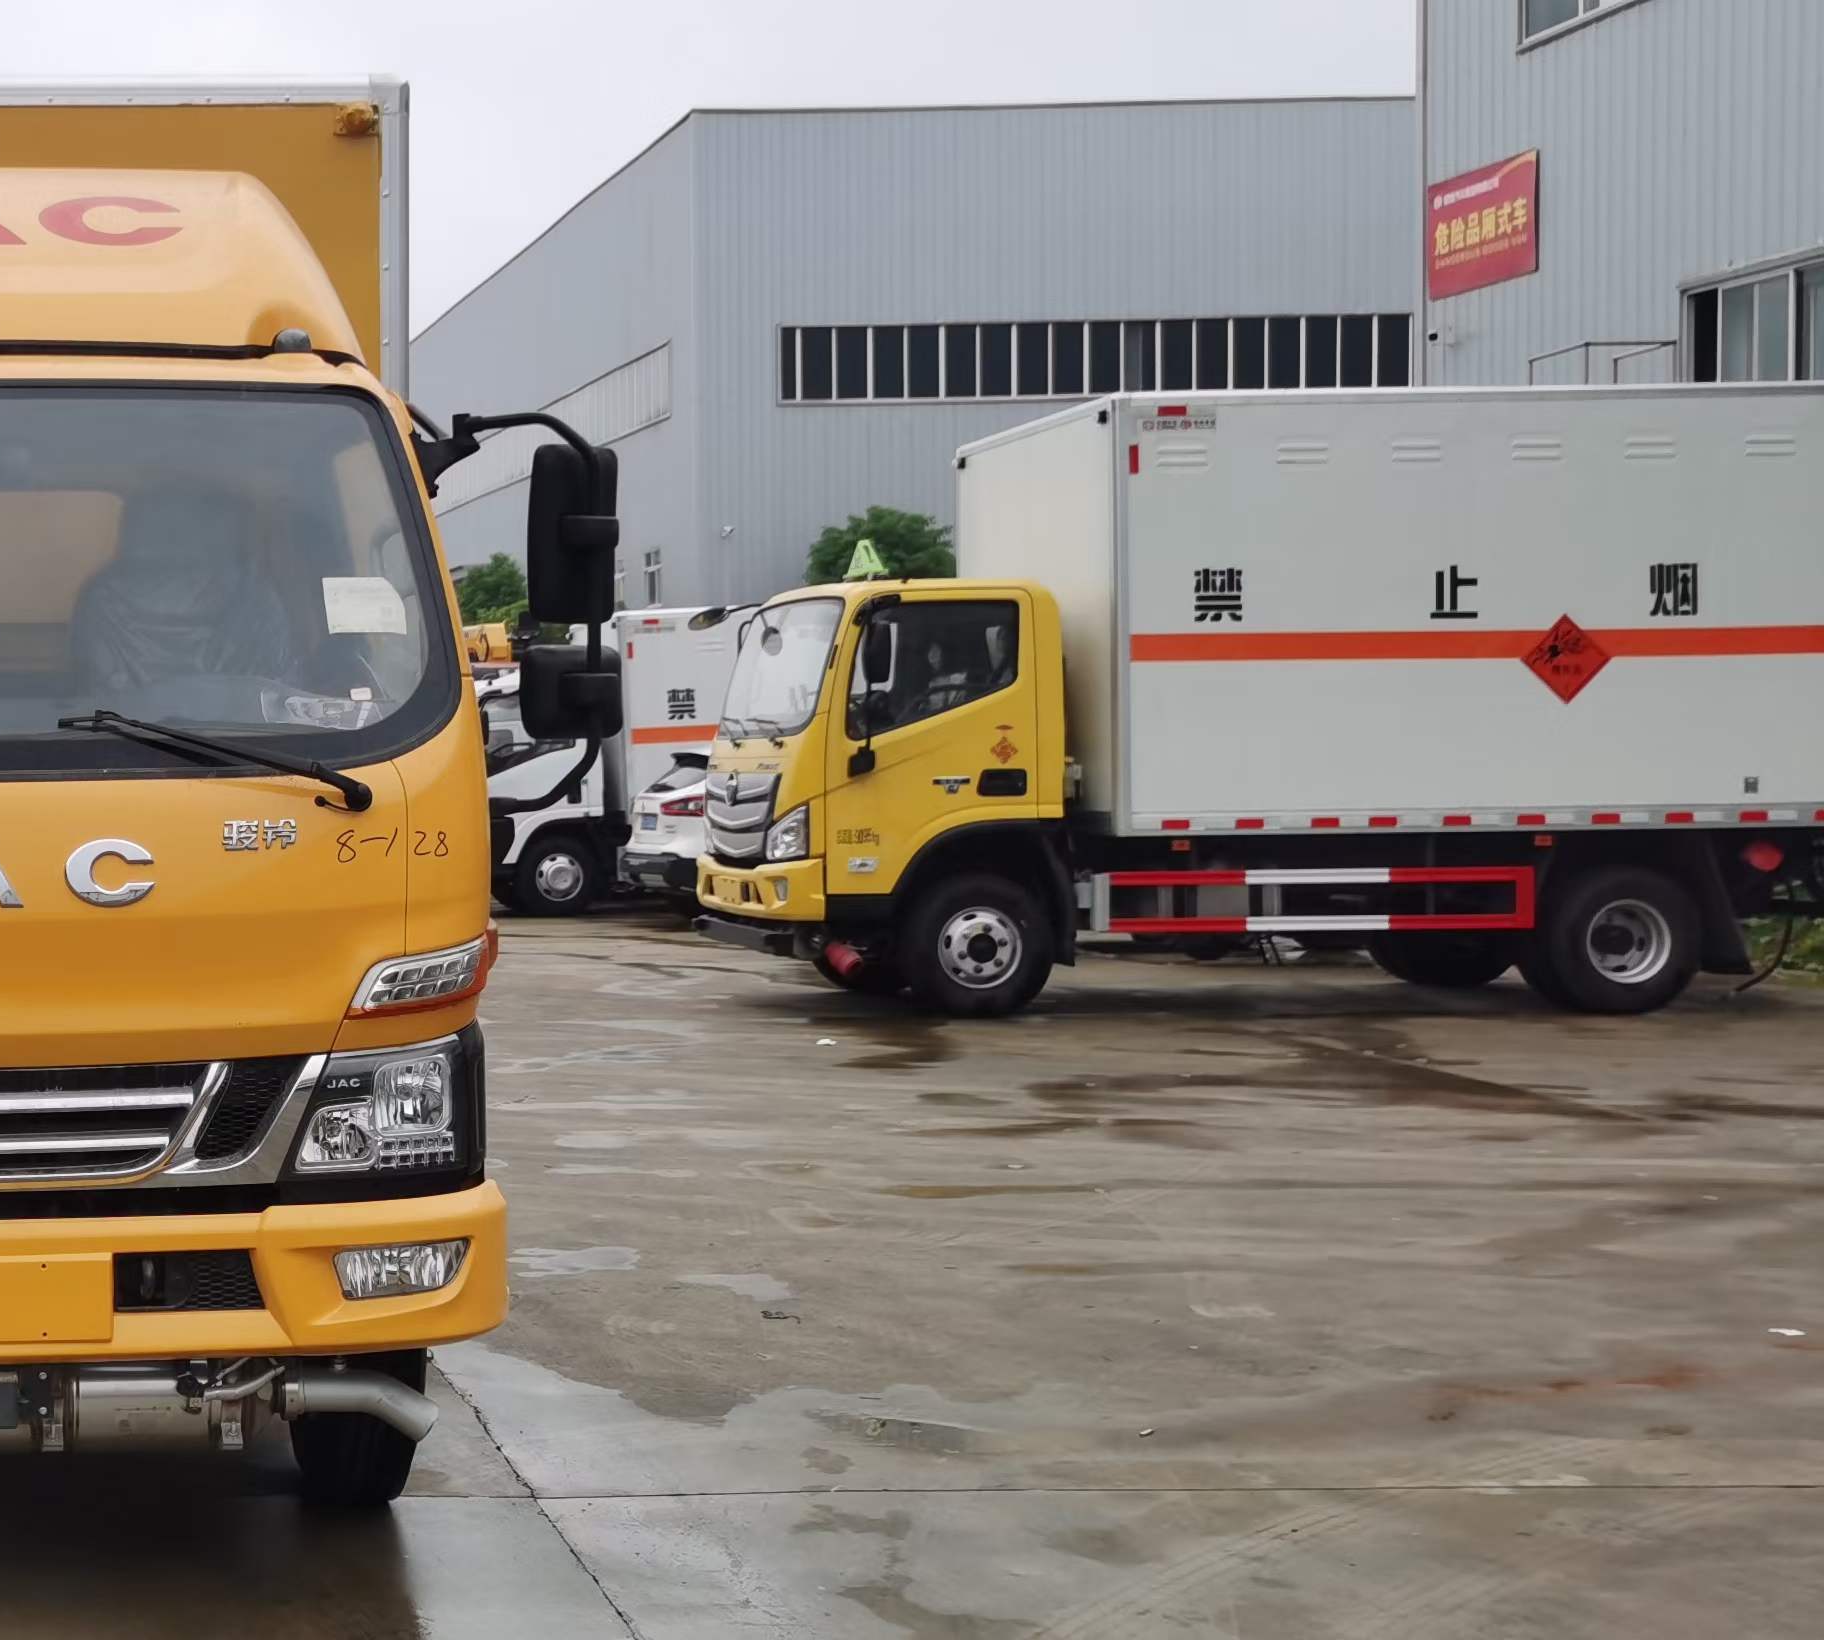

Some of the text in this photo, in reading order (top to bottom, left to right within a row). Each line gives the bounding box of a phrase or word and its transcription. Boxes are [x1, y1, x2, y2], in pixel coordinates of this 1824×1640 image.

[1434, 196, 1528, 257] 危险品厢式车
[1193, 561, 1699, 622] 禁 止 烟
[666, 688, 697, 721] 禁
[222, 818, 298, 851] 骏铃
[326, 1076, 362, 1090] JAC
